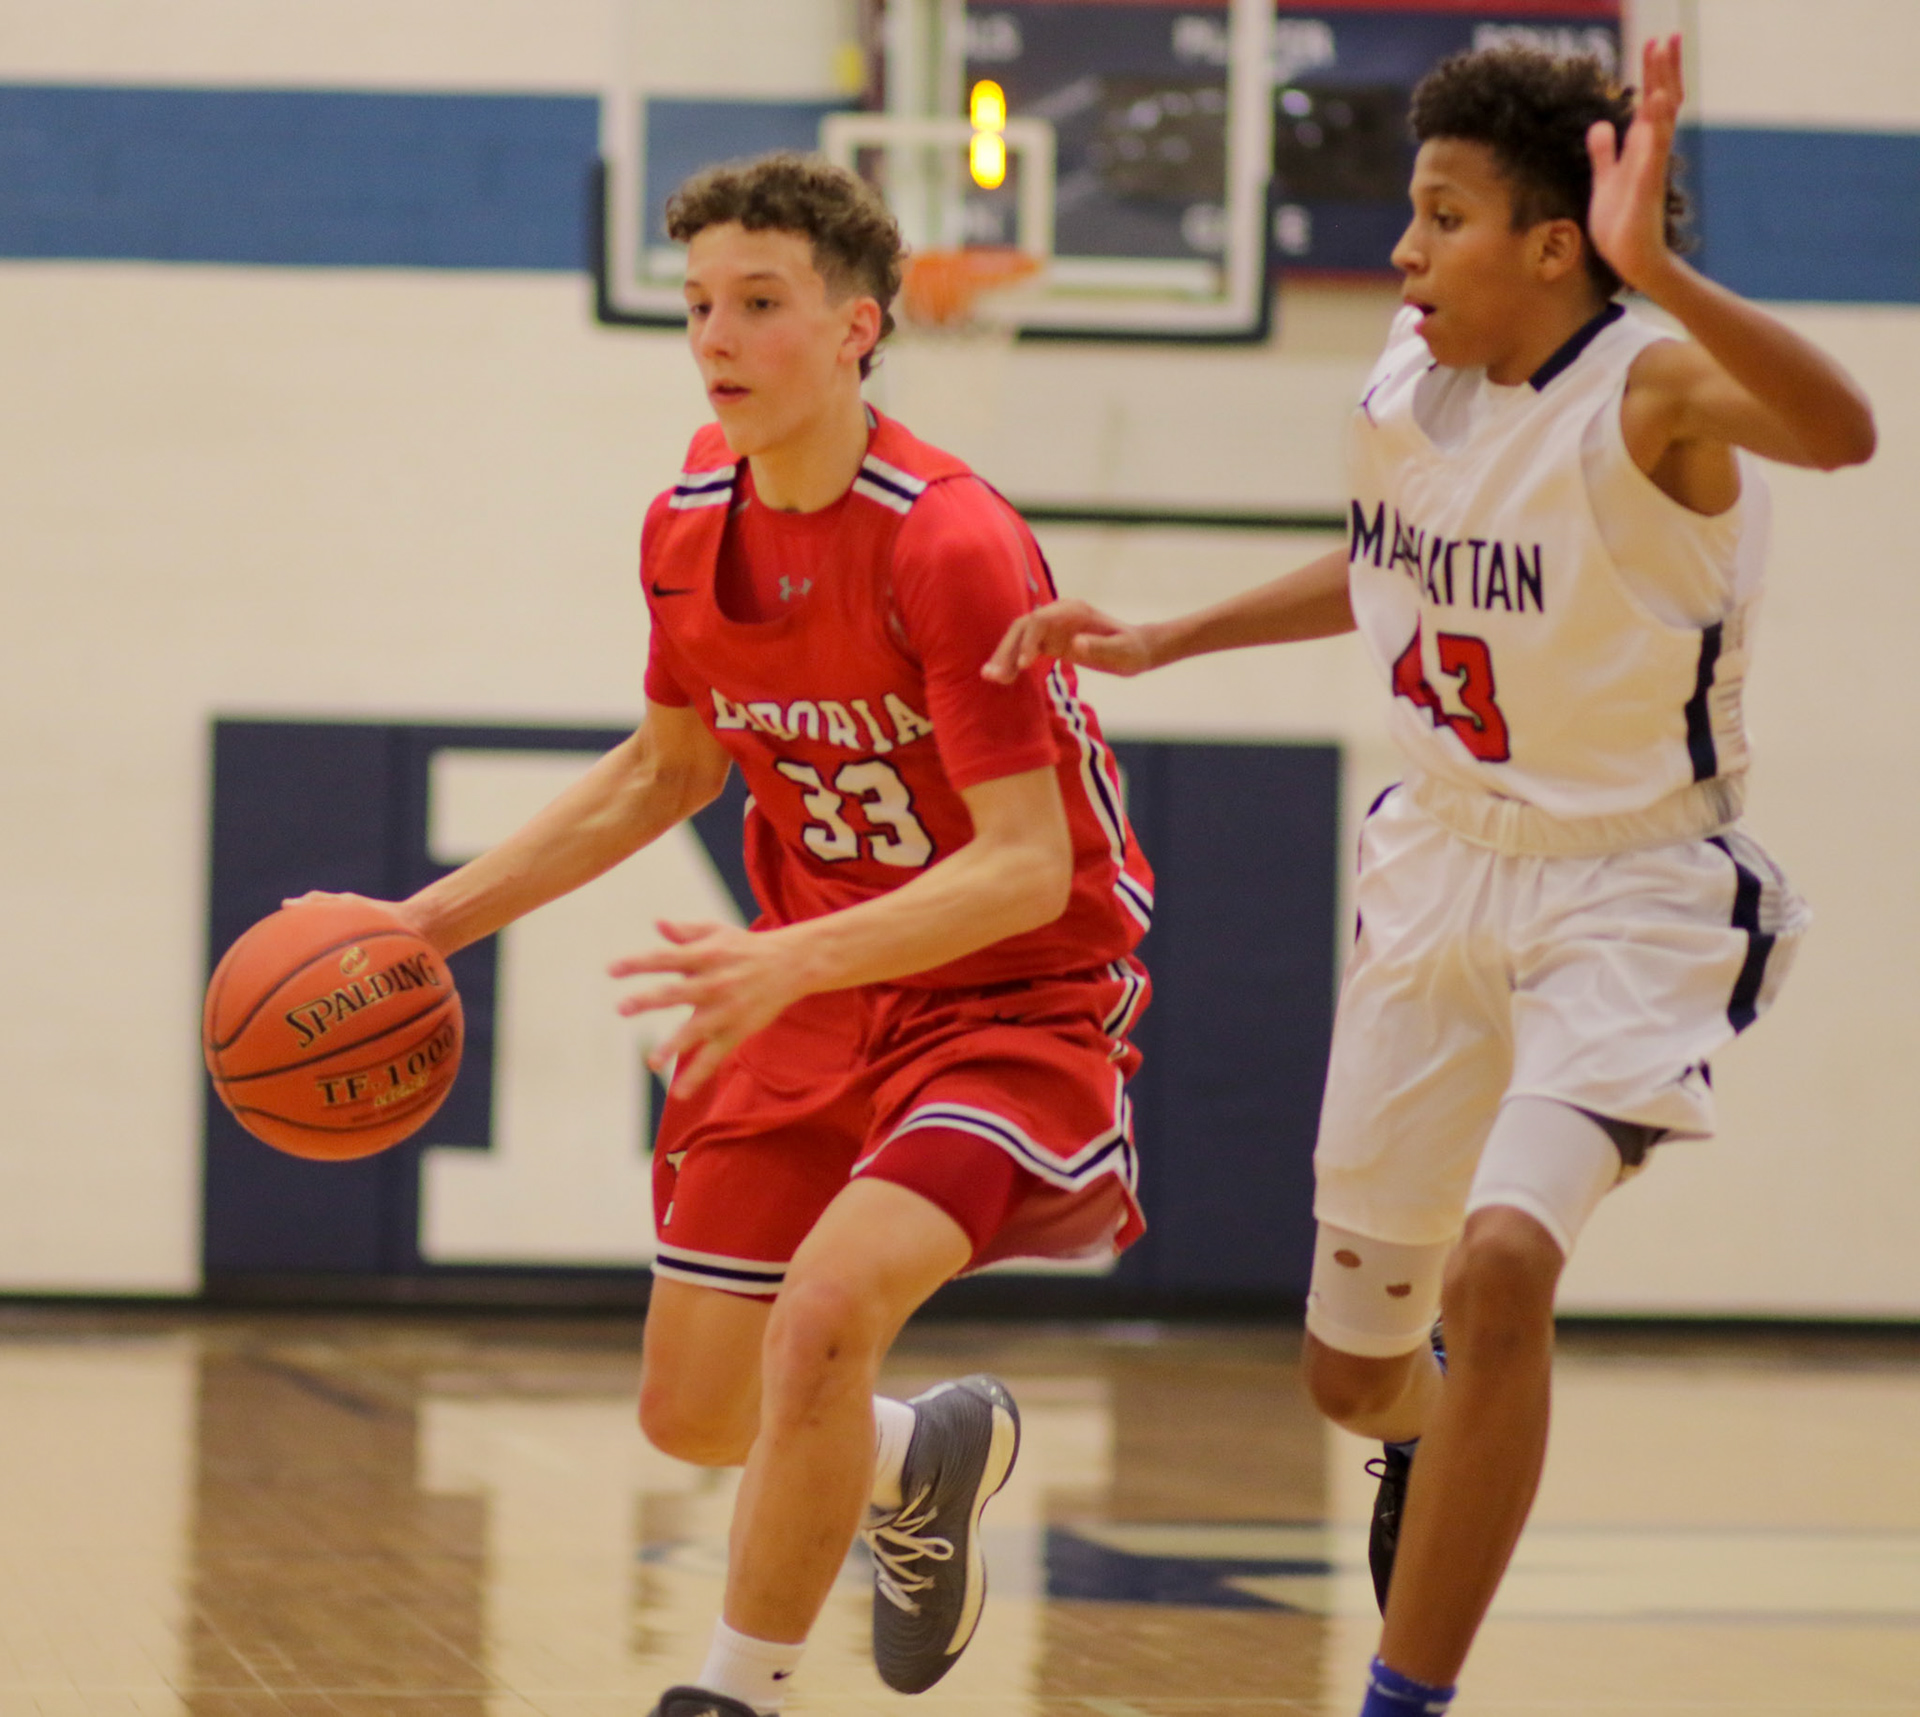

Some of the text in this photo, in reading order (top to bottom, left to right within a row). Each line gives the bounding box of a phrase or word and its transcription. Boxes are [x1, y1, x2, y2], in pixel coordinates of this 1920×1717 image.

[1349, 499, 1544, 613] MATTAN
[774, 757, 935, 869] 33
[284, 953, 441, 1048] SPALDING
